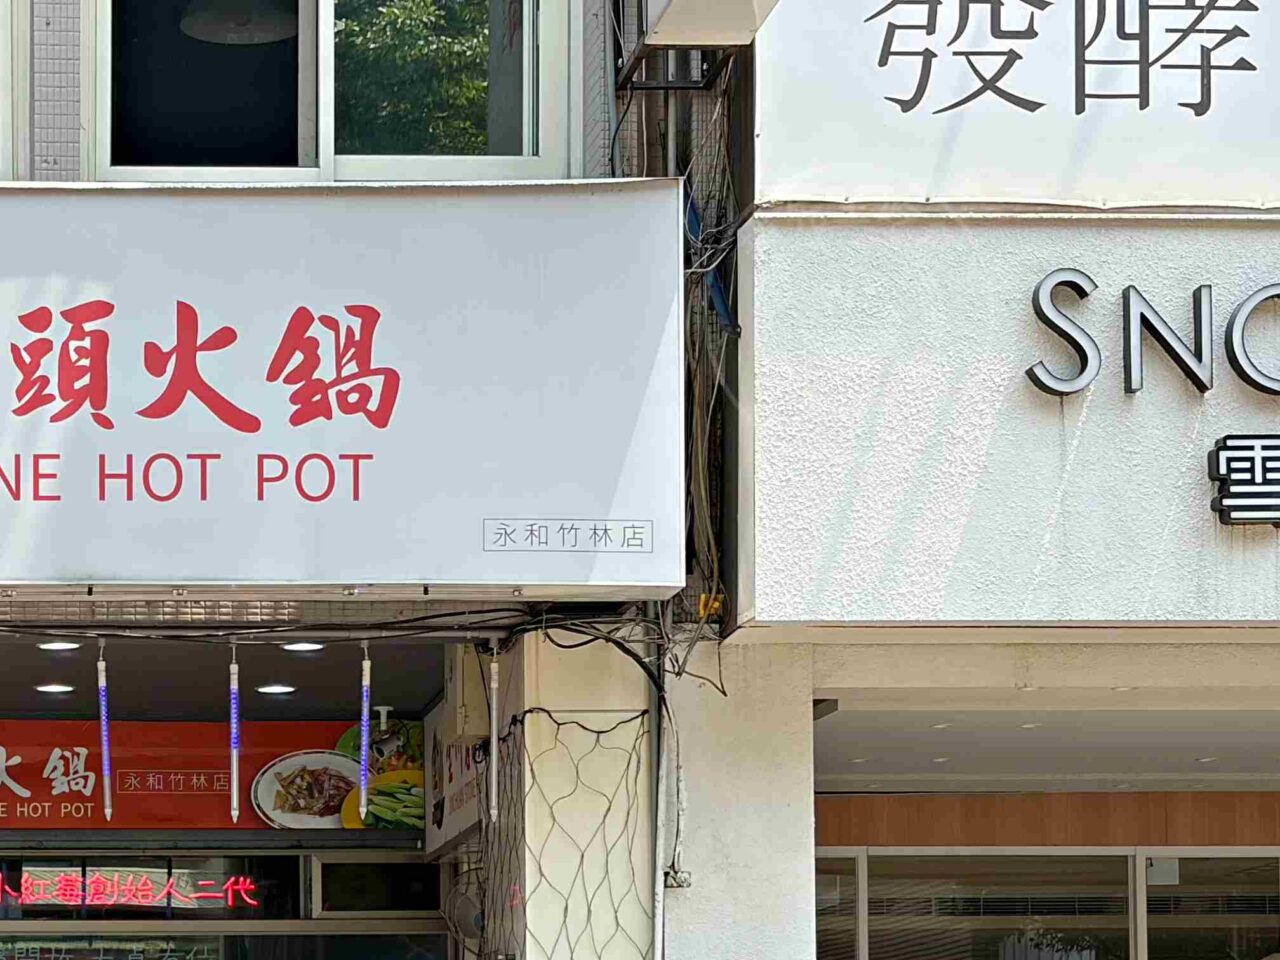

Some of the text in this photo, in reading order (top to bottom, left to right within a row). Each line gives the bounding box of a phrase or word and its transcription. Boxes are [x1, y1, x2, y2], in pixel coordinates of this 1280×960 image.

[98, 453, 221, 502] HOT
[257, 453, 374, 502] POT
[493, 522, 645, 550] 永和竹林店
[123, 773, 230, 791] 永和竹林店
[16, 801, 52, 818] HOT
[60, 801, 95, 818] POT
